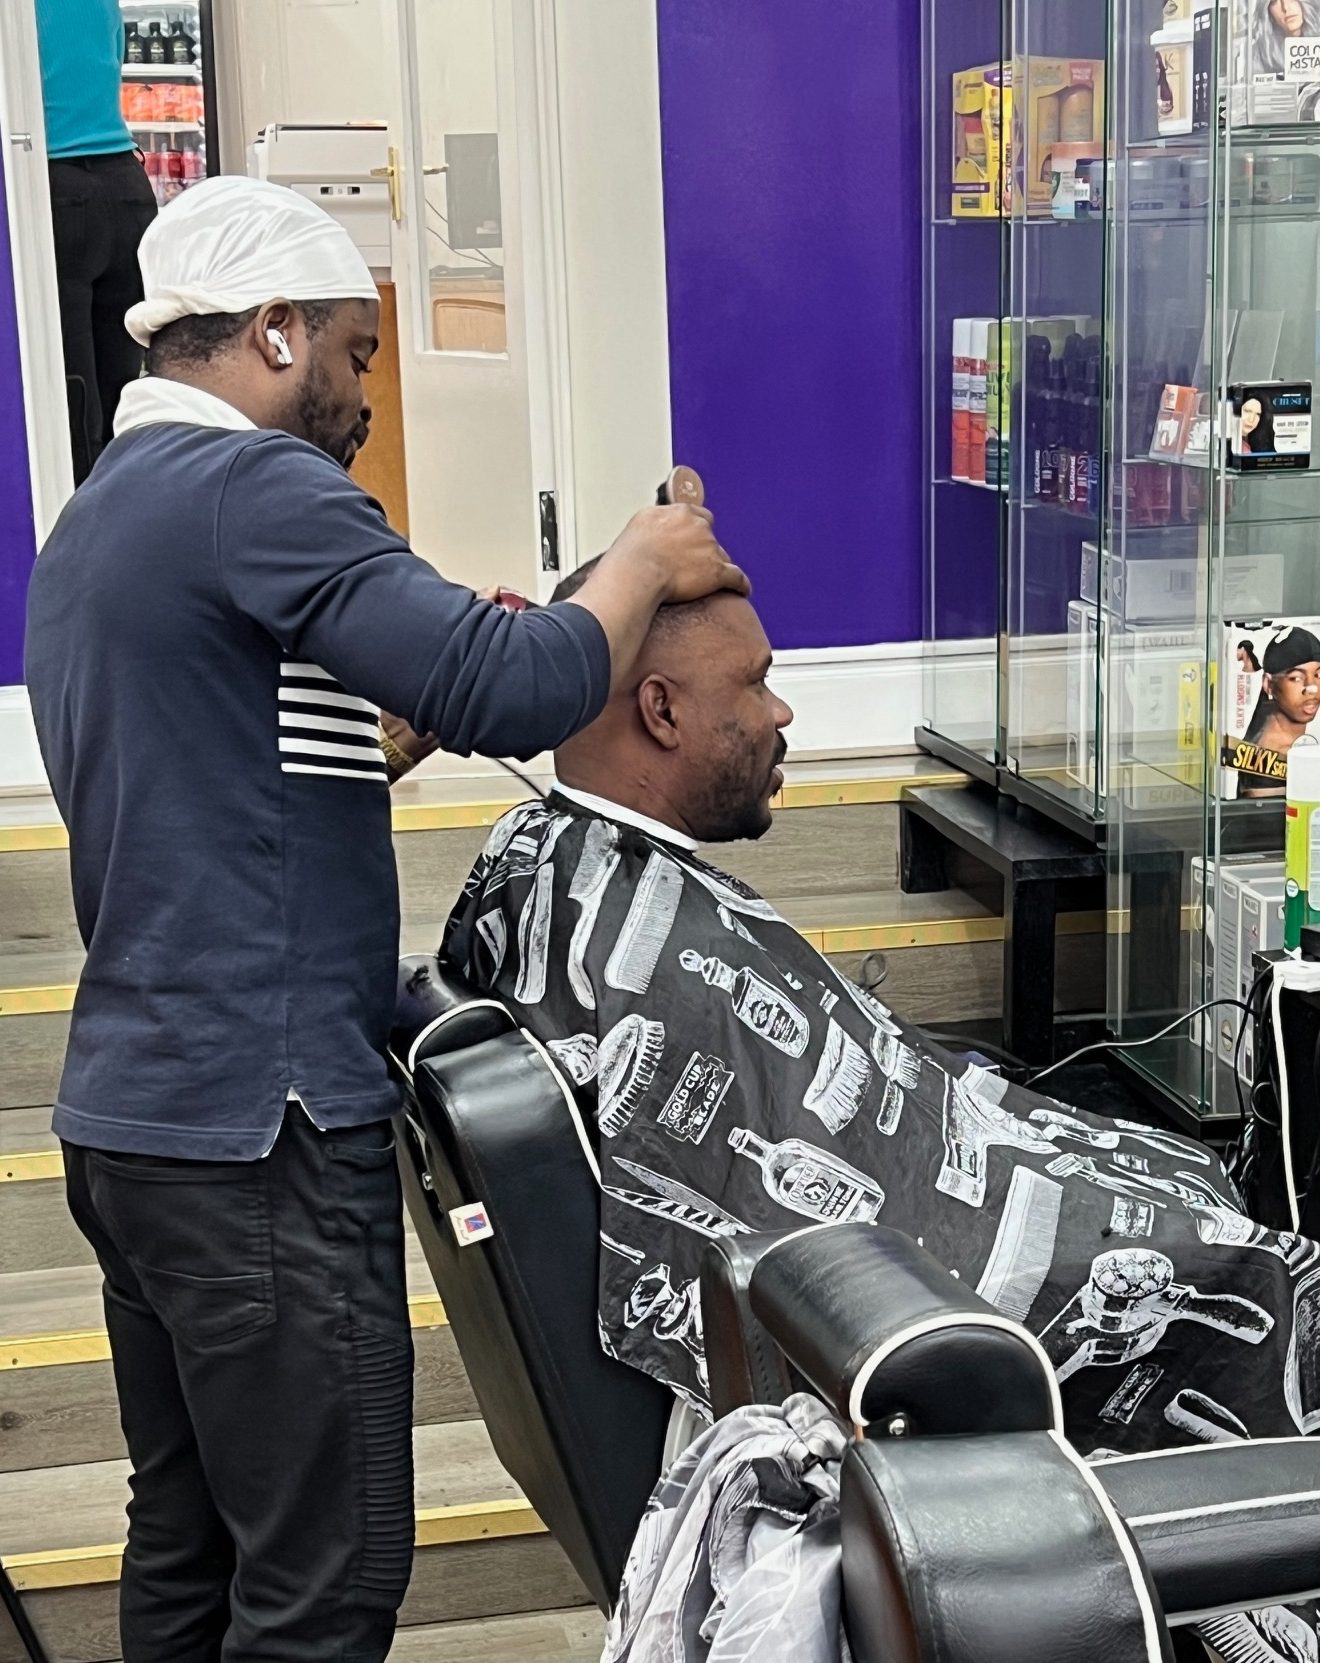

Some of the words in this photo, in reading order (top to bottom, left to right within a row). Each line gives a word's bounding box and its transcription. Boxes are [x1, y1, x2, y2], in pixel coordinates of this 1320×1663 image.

[1232, 743, 1278, 775] SILKY
[667, 1088, 690, 1120] GOLD
[685, 1064, 703, 1089] CUP
